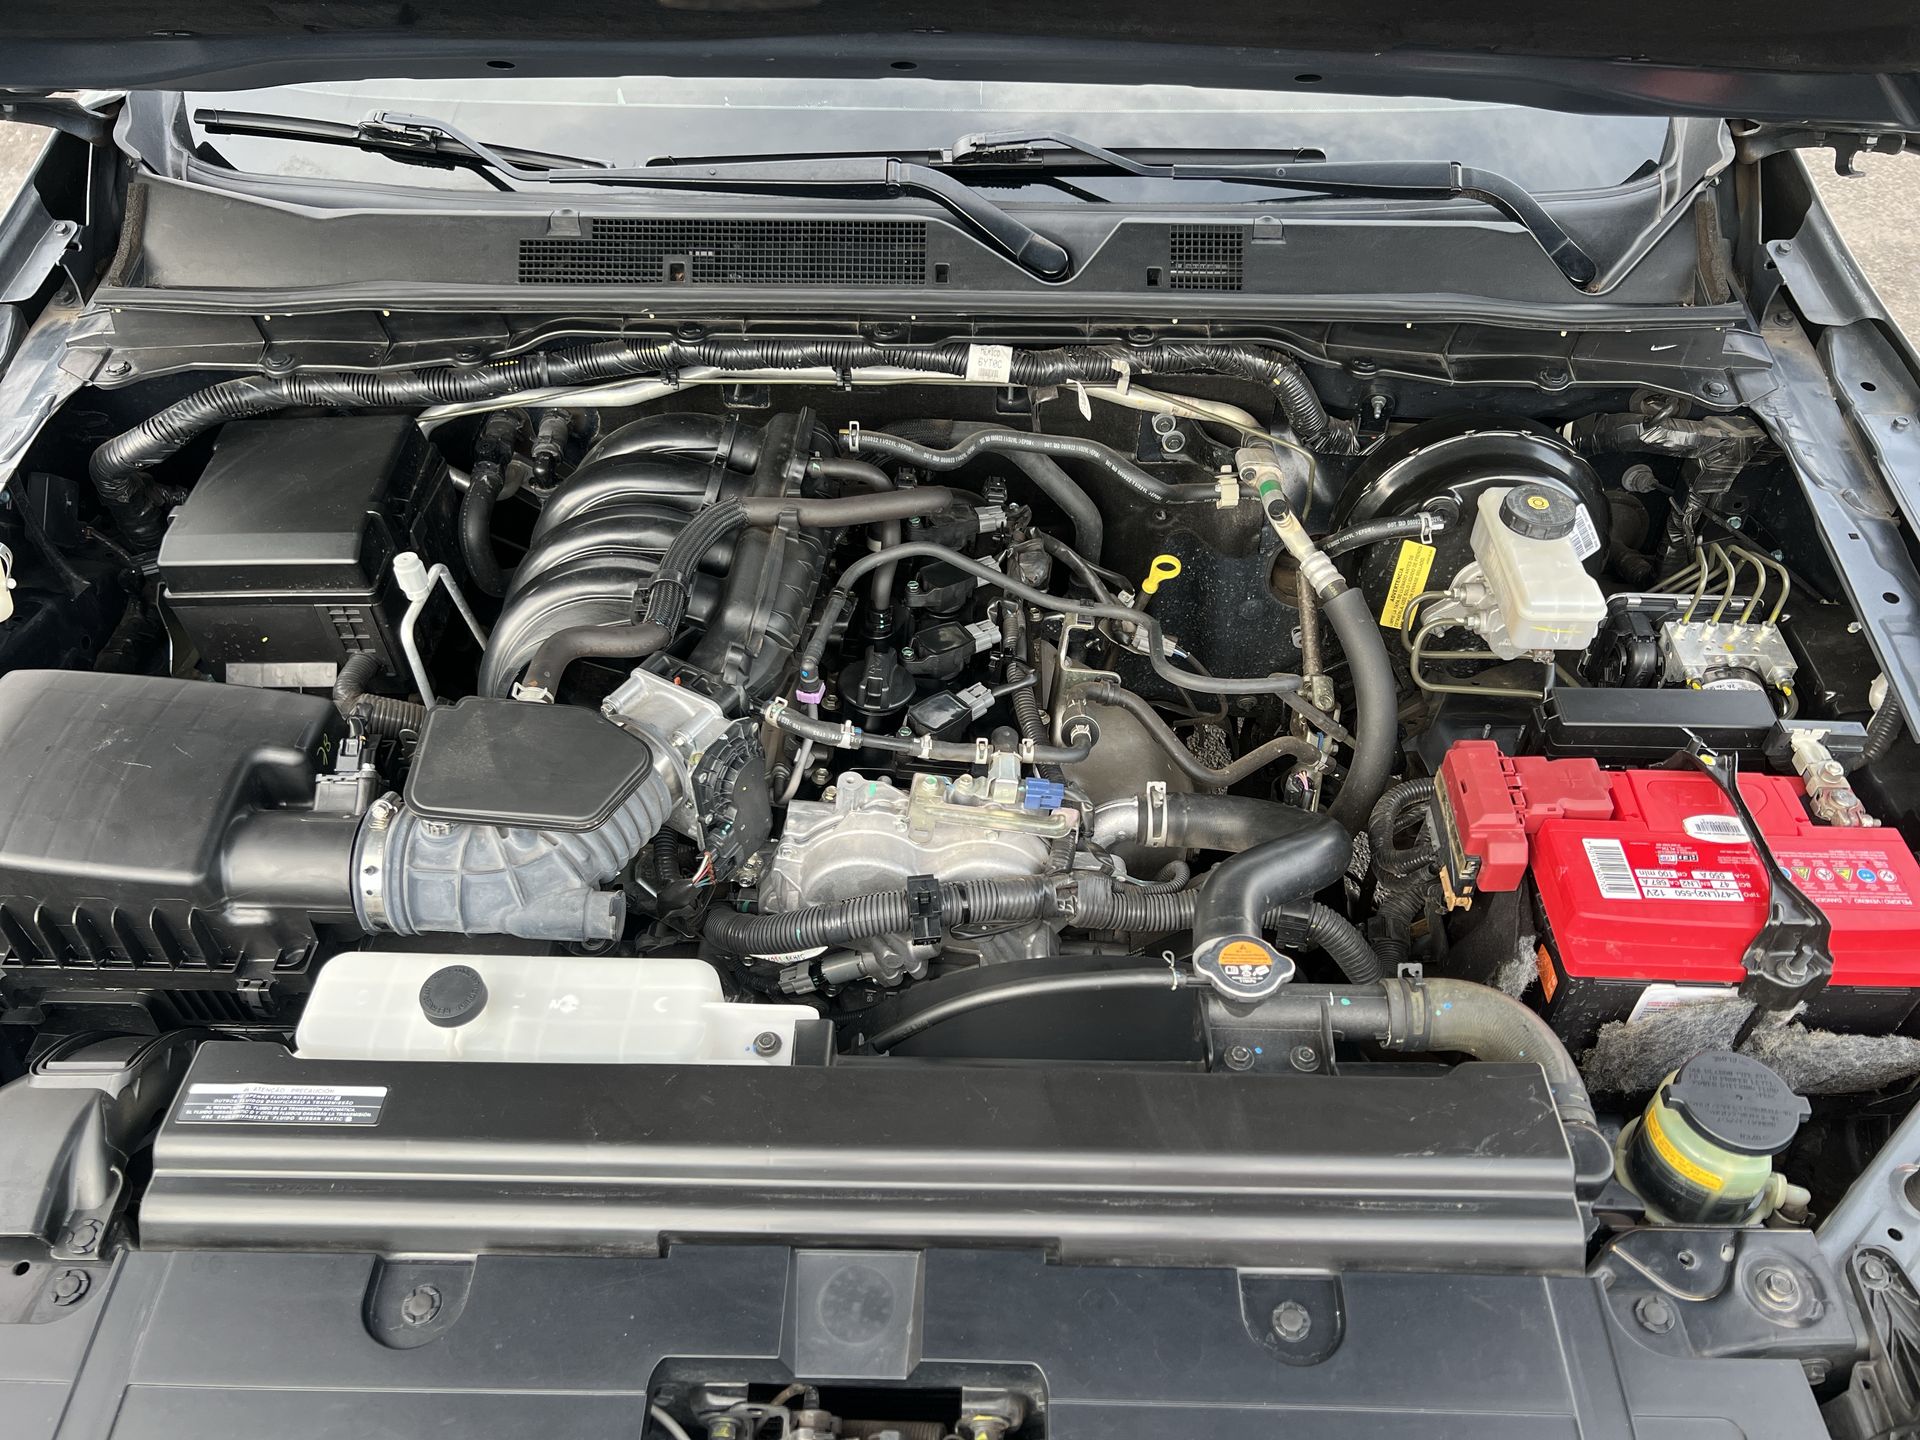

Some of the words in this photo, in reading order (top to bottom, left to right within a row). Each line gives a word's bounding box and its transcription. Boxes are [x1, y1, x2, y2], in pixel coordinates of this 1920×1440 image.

[1389, 566, 1404, 601] ADVERTENCIA
[1658, 870, 1673, 878] 100
[1646, 888, 1666, 897] 12V
